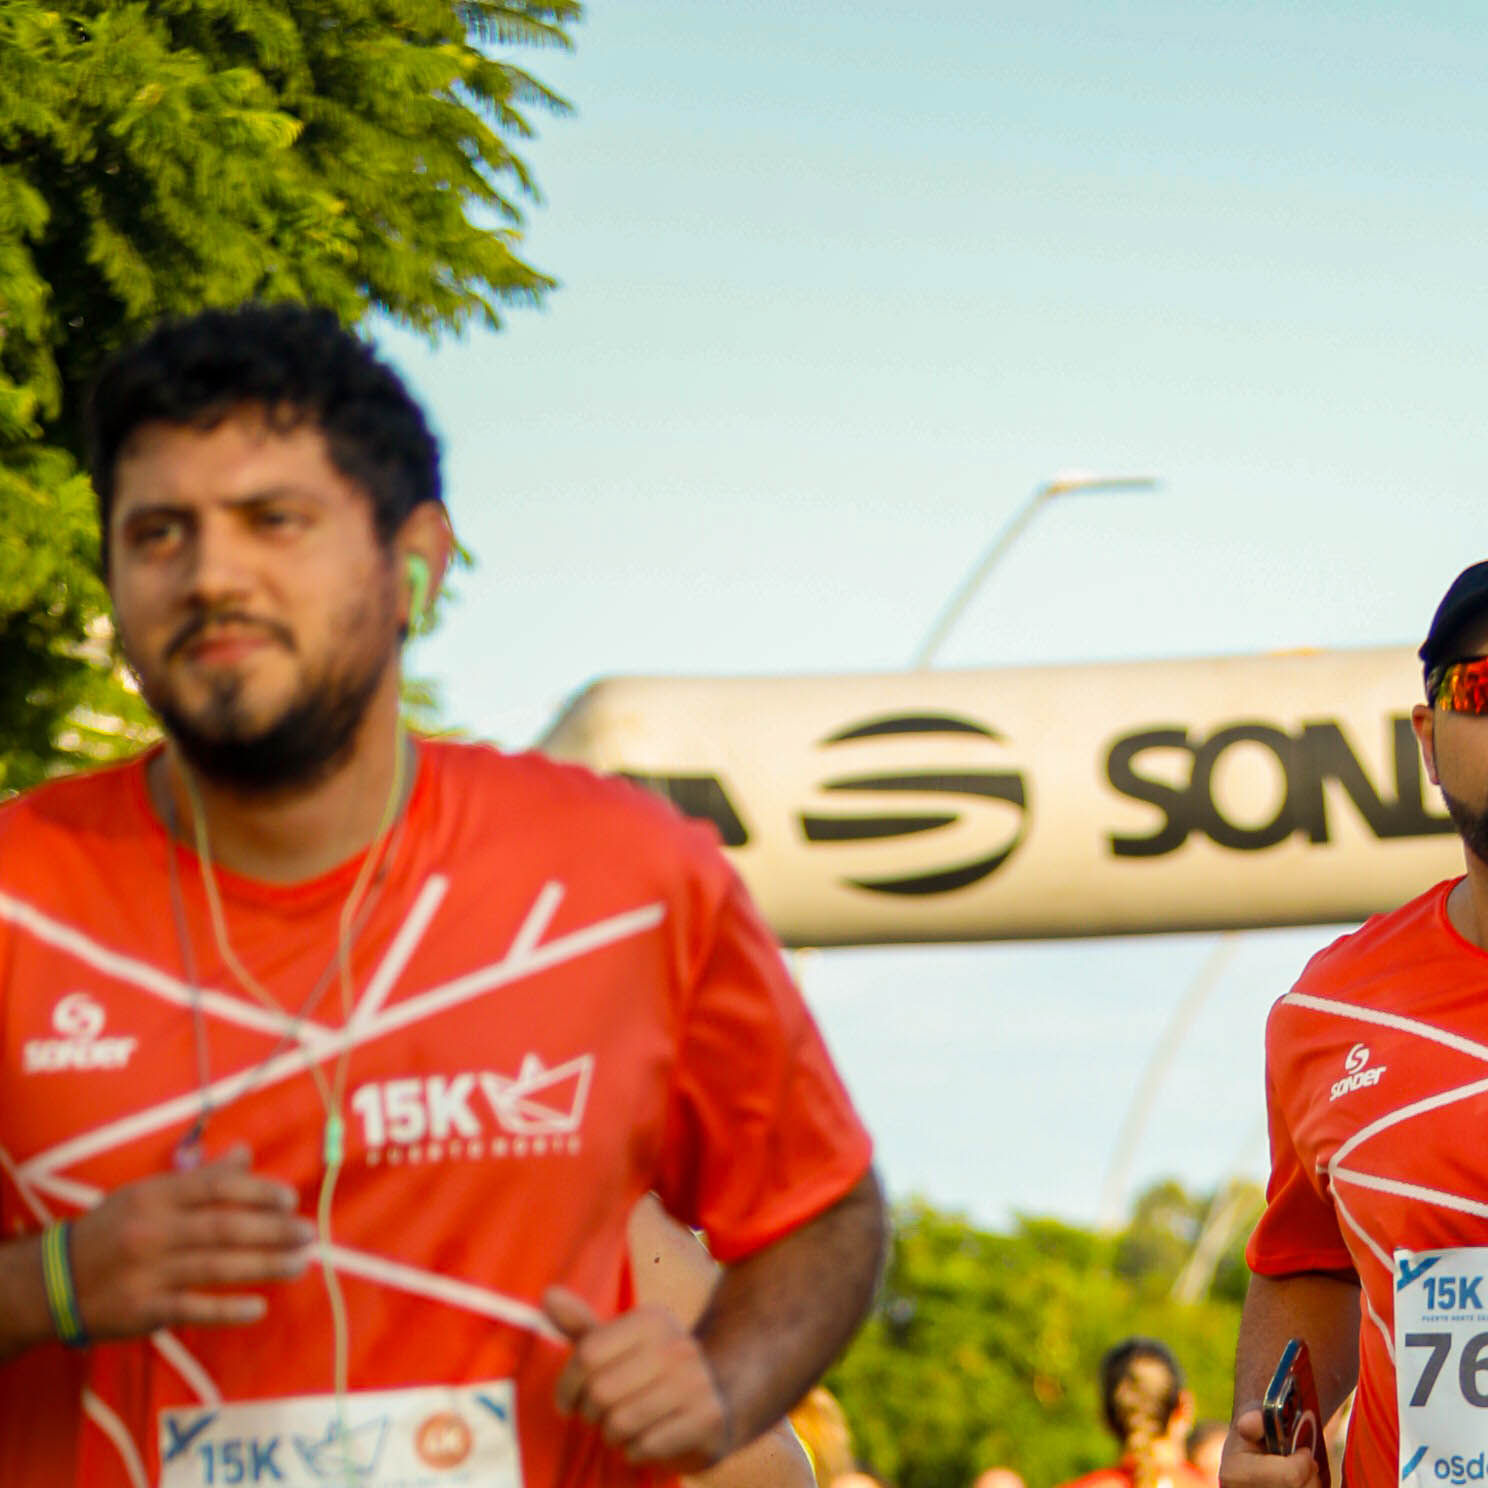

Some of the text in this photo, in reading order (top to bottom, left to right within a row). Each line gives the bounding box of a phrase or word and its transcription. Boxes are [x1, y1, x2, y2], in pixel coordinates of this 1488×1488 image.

[352, 1071, 482, 1148] 15K
[1422, 1276, 1484, 1310] 15K
[198, 1435, 283, 1486] 15K
